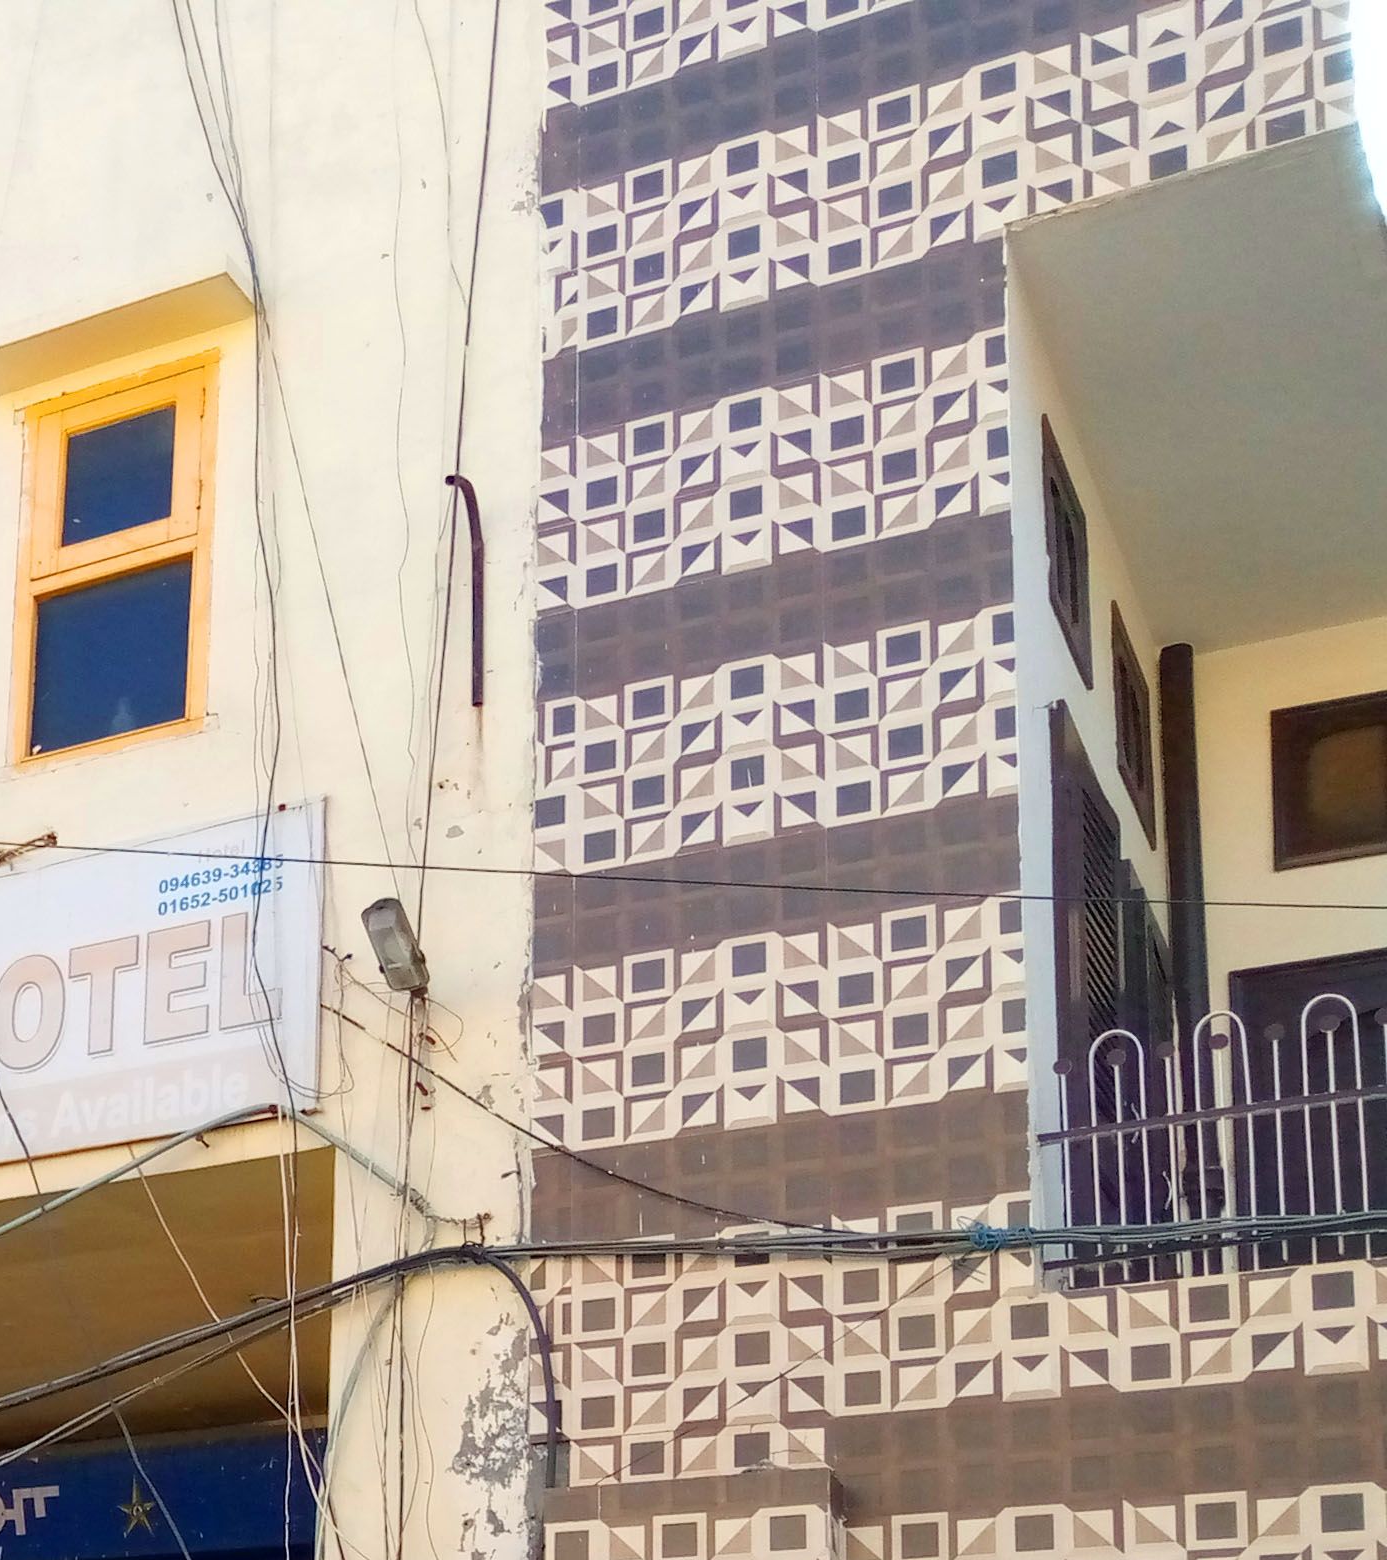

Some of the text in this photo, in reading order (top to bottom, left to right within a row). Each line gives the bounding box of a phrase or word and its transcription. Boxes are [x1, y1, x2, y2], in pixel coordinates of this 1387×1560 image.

[158, 852, 285, 895] 094639-34385
[157, 875, 284, 917] 01652-501025
[50, 1066, 249, 1138] Available
